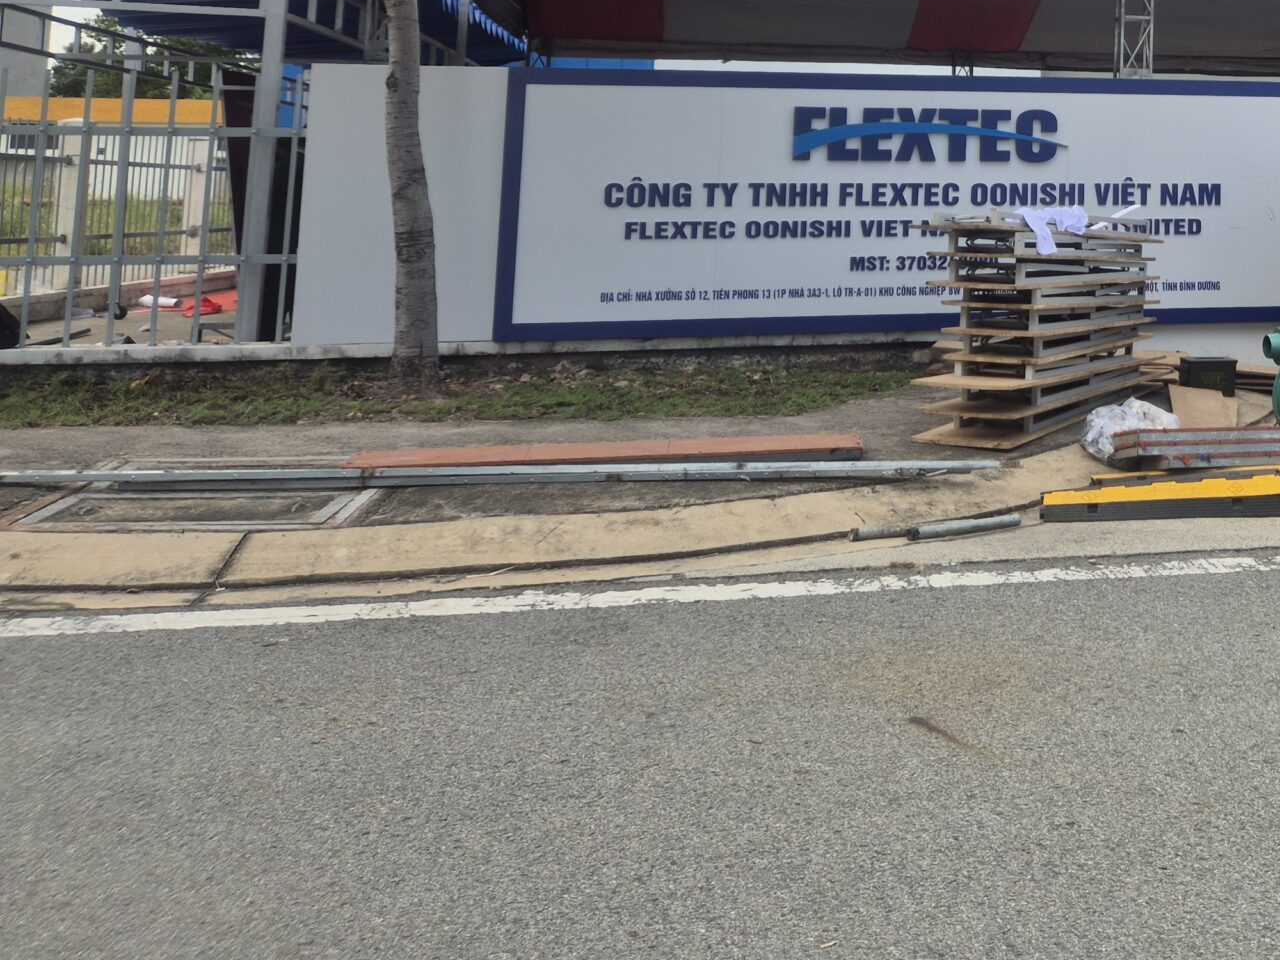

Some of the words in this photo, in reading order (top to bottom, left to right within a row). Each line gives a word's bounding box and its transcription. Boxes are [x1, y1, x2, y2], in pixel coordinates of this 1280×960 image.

[792, 106, 1059, 163] FLEXTEC
[603, 176, 692, 208] CÔNG
[702, 183, 738, 208] TY
[749, 182, 829, 207] TNHH
[838, 182, 960, 207] FLEXTEC
[970, 182, 1085, 207] OONISHI
[1160, 182, 1222, 207] NAM
[624, 220, 736, 241] FLEXTEC
[745, 220, 851, 239] OONISHI
[860, 219, 912, 238] VIET
[849, 255, 890, 272] MST:
[600, 291, 614, 304] ĐỊA
[635, 289, 652, 301] NHÀ
[698, 290, 709, 301] 12,
[732, 288, 759, 300] PHONG
[762, 288, 771, 299] 13
[773, 288, 786, 299] (1P
[879, 286, 894, 297] KHU
[896, 284, 917, 297] CÔNG
[1179, 279, 1196, 291] BÌNH
